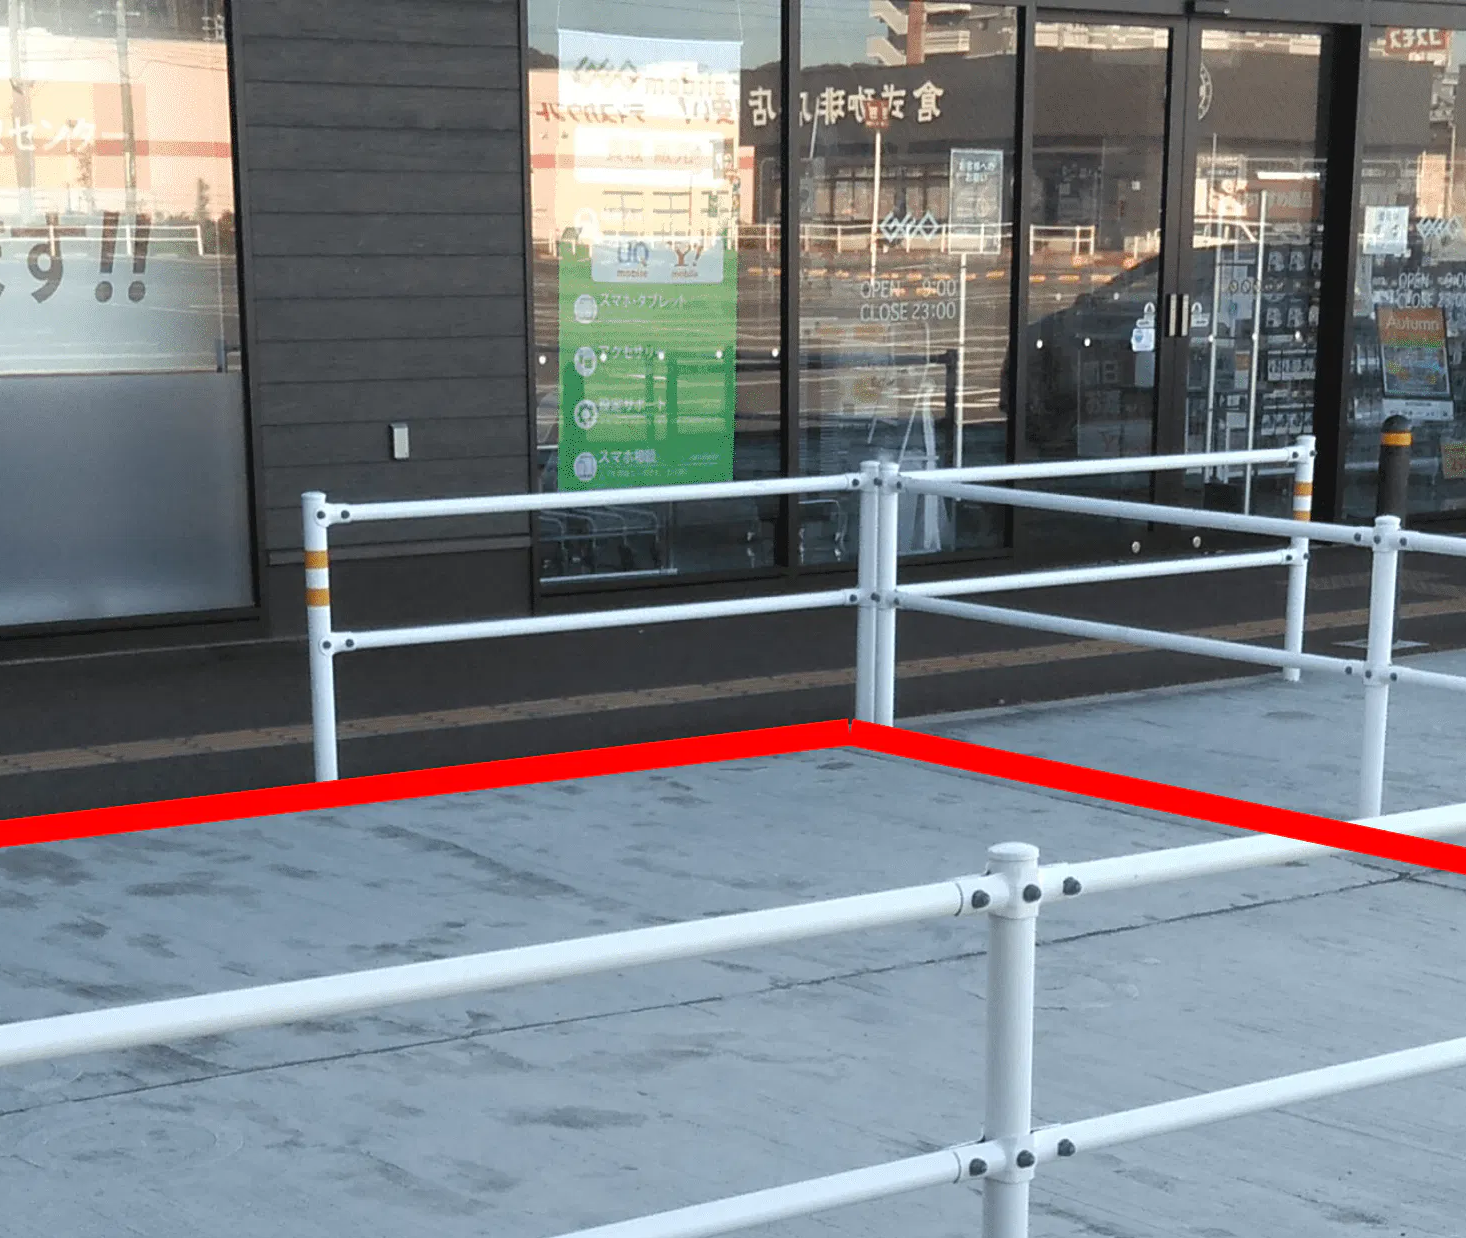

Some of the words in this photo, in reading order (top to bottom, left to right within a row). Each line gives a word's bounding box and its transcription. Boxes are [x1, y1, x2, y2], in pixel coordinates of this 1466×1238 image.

[860, 281, 901, 299] OPEN
[921, 280, 957, 298] 9:00
[1398, 272, 1430, 289] OPEN
[860, 301, 908, 322] CLOSE
[912, 301, 956, 321] 23:00
[1386, 315, 1441, 331] Autumn
